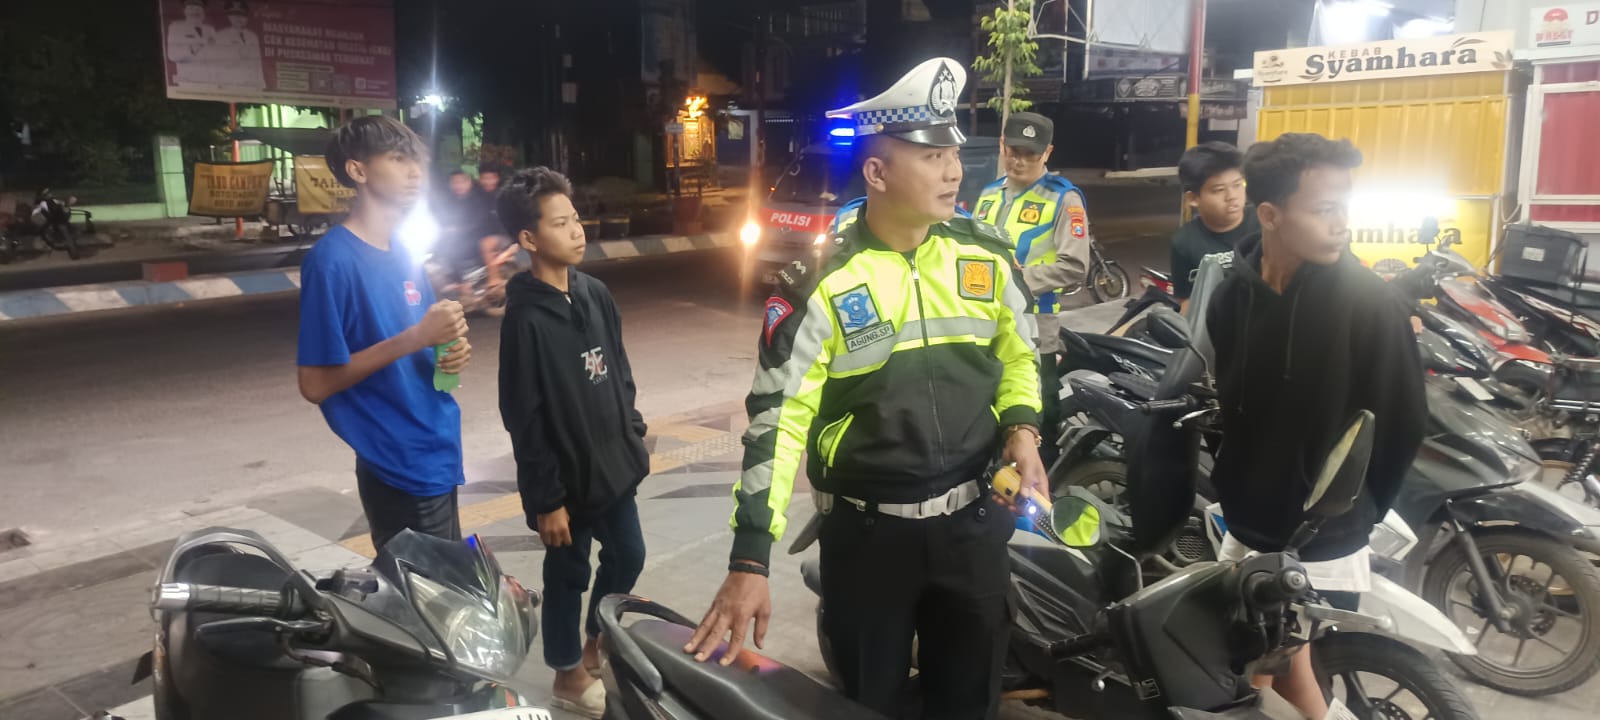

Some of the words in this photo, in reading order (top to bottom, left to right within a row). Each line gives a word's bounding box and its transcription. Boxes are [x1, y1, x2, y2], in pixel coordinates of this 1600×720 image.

[1327, 46, 1382, 59] KEBAB
[1305, 46, 1477, 79] Syamhara
[769, 212, 812, 227] POLISI
[849, 326, 890, 349] AGUNG.SP
